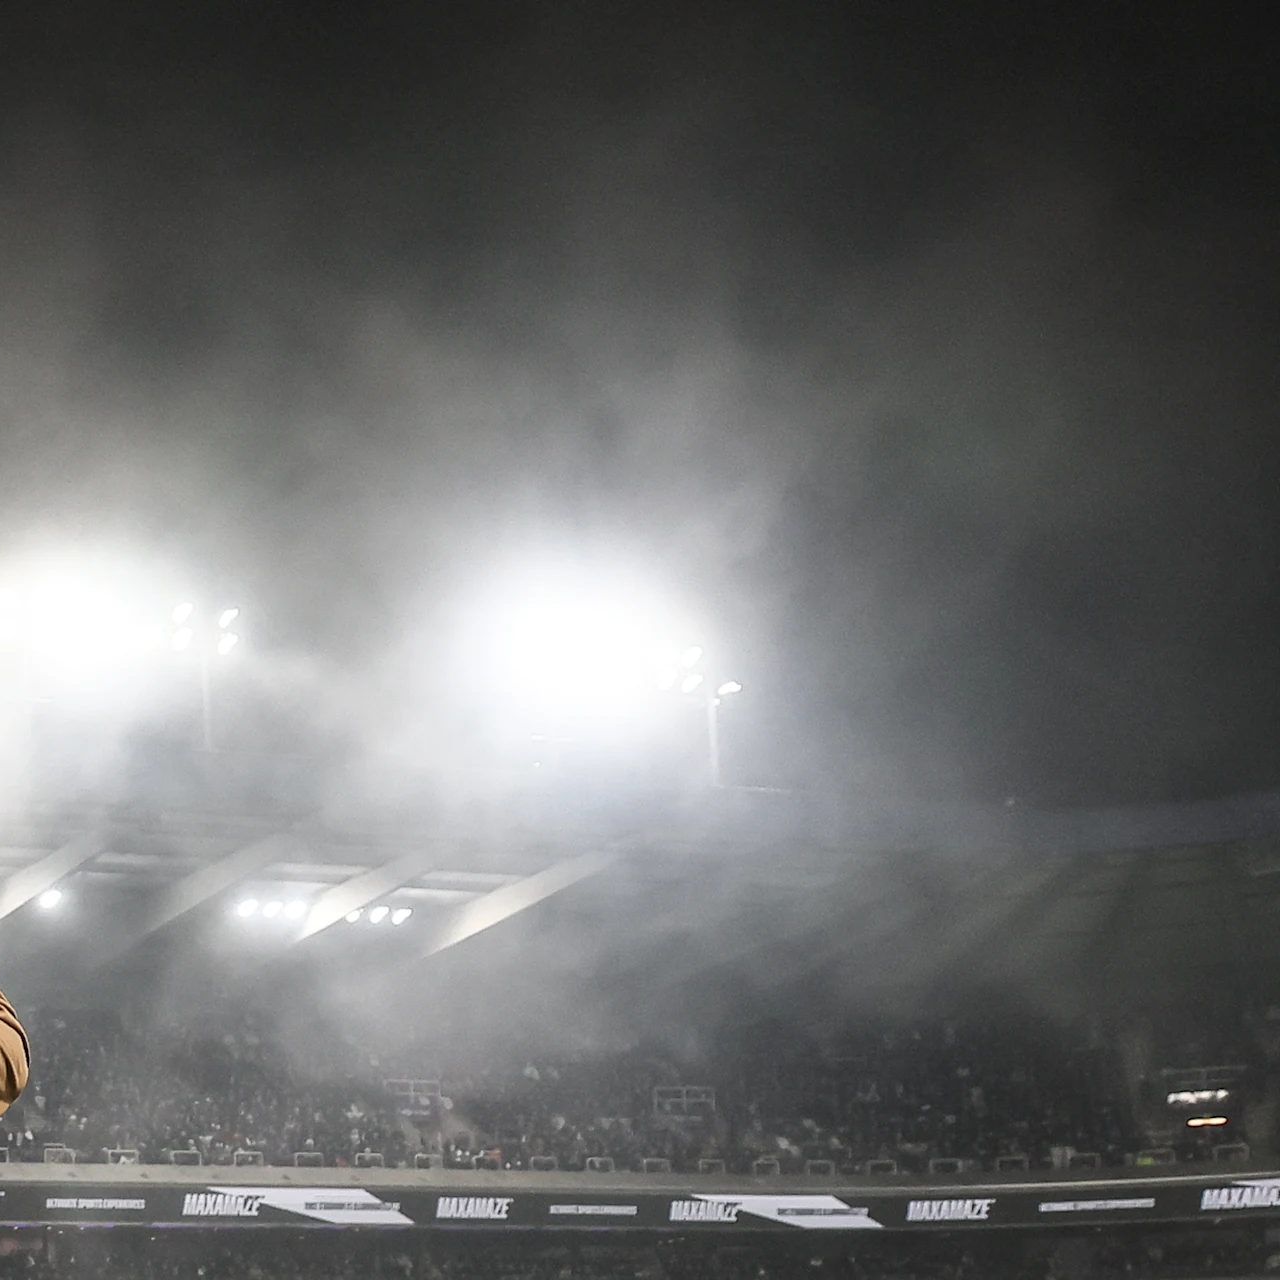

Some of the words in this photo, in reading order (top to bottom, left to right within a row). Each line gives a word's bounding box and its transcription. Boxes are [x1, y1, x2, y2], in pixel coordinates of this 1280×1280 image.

[182, 1193, 262, 1216] MAXAMAZE
[436, 1197, 512, 1219] MAXAMAZE
[906, 1199, 995, 1221] MAXAMAZE
